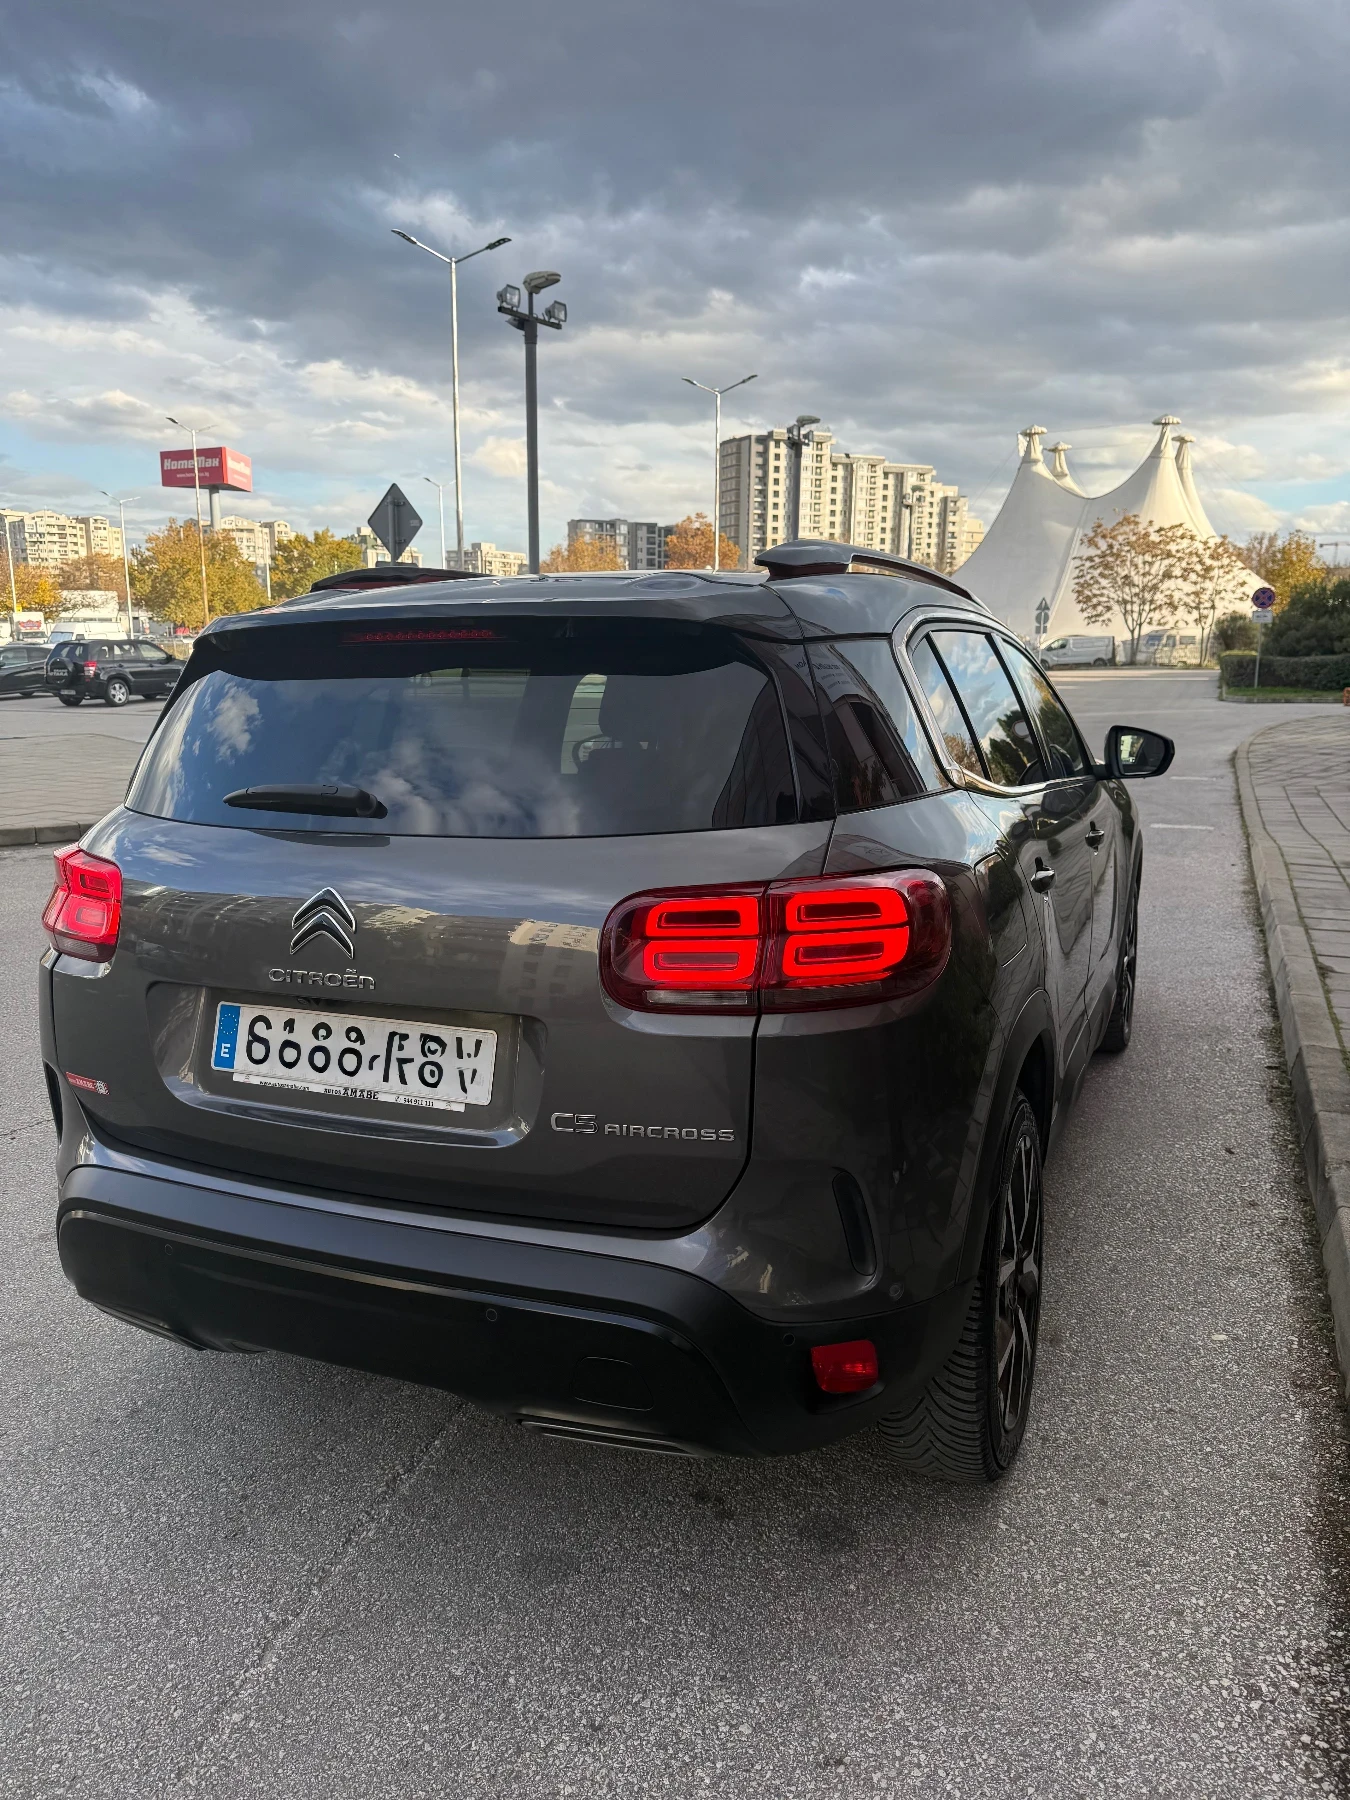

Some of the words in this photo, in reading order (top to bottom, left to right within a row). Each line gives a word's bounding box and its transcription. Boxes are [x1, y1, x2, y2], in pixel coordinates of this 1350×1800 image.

[220, 1043, 231, 1058] E
[342, 1086, 380, 1100] AMABE
[550, 1112, 599, 1134] C5
[604, 1123, 736, 1142] AIRCROSS
